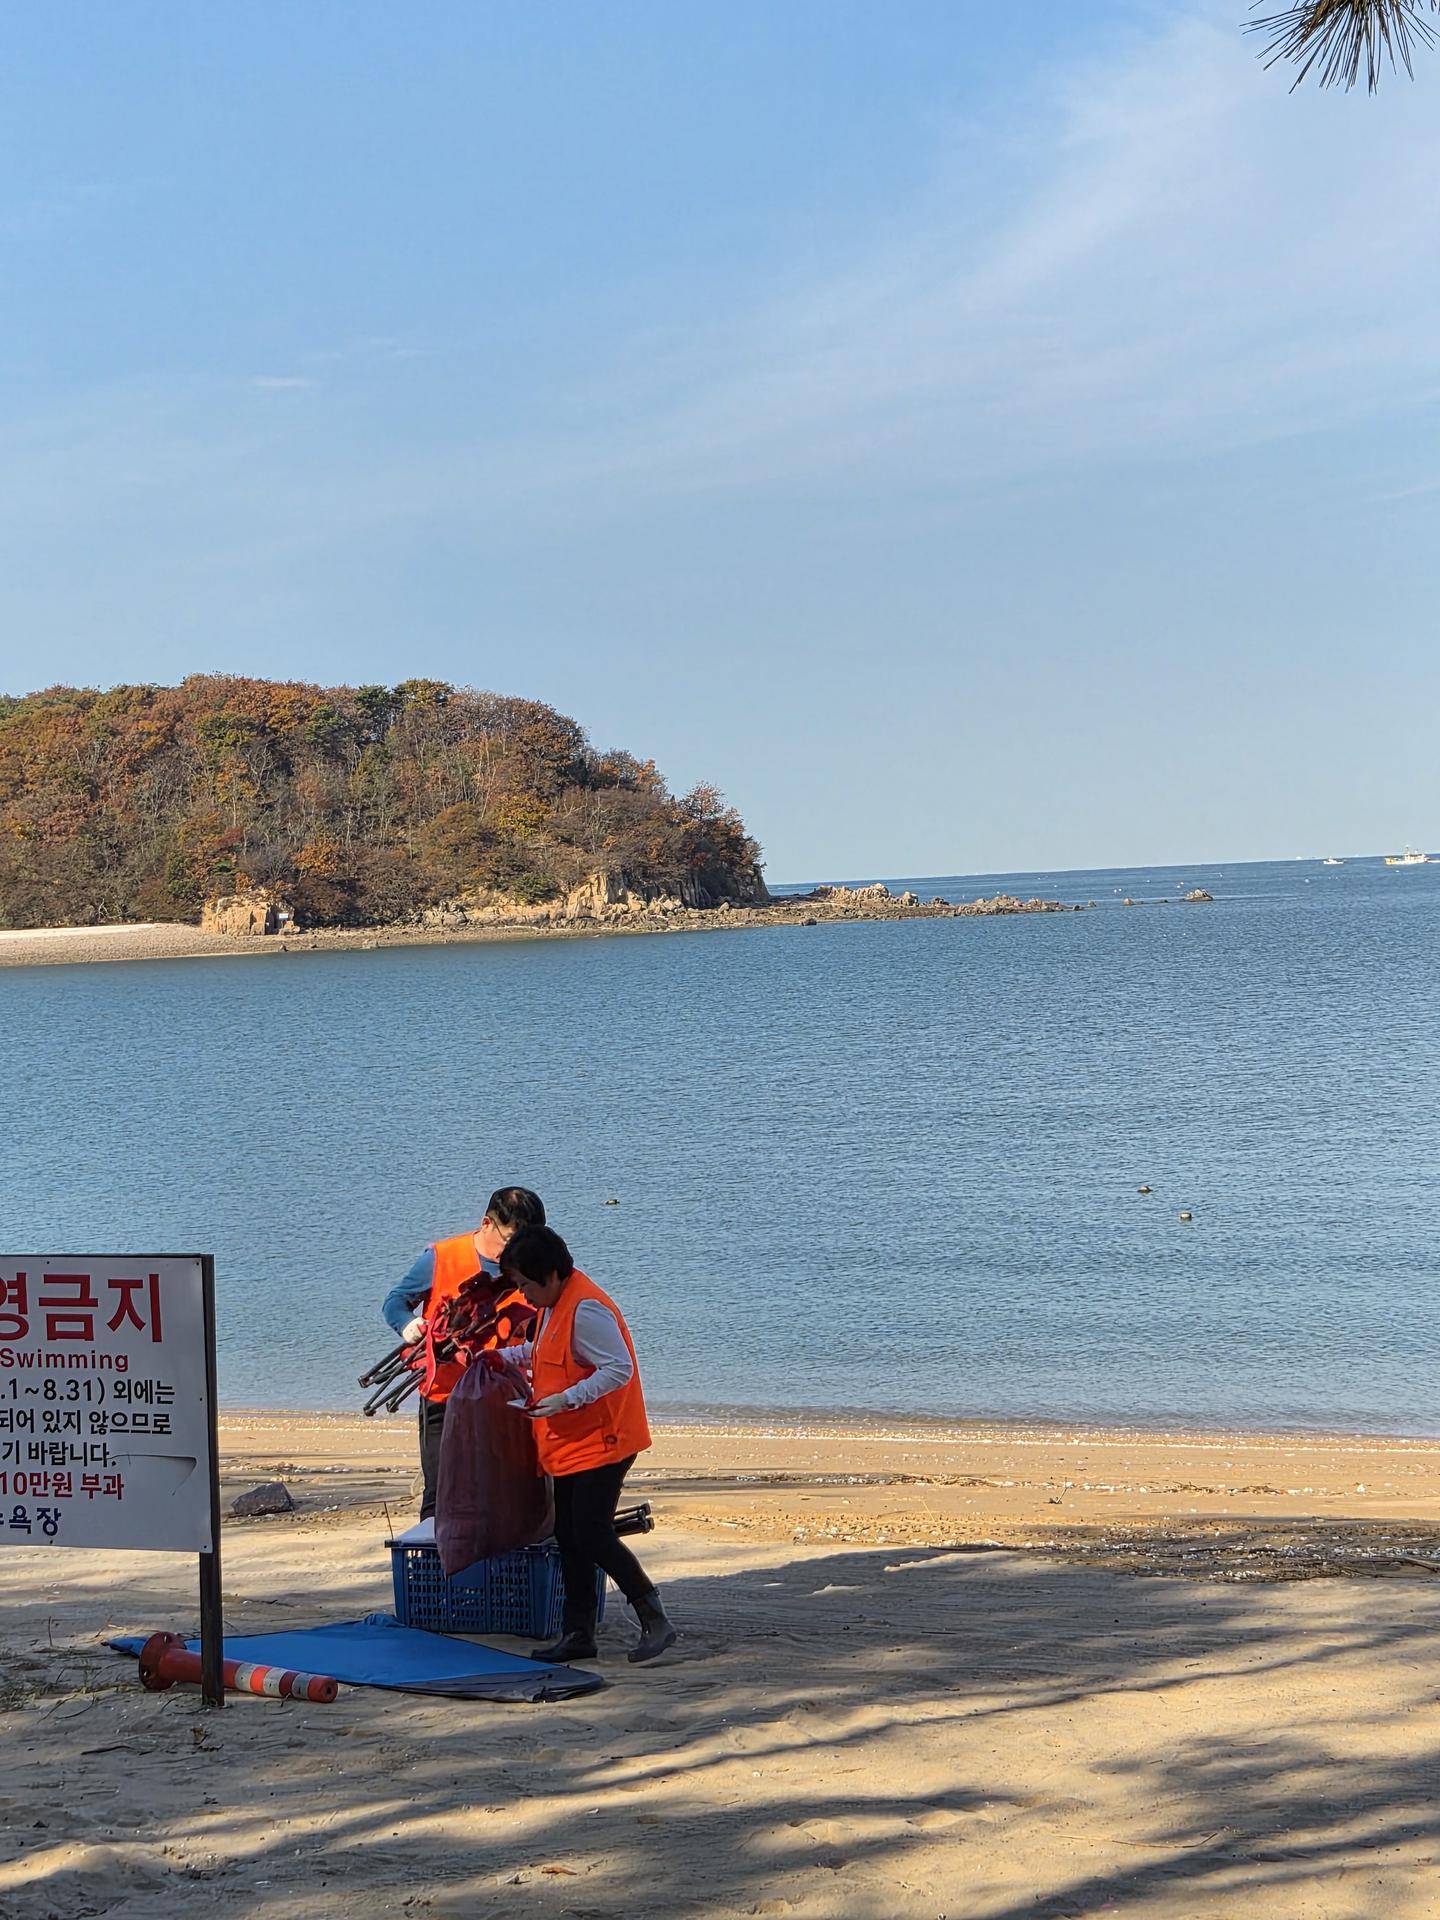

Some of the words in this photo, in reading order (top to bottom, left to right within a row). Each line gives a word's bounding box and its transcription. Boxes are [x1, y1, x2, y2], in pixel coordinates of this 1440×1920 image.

[0, 1347, 129, 1372] Swimming
[113, 1379, 175, 1404] 외에는
[42, 1409, 81, 1435] 있지
[88, 1410, 172, 1436] 않으므로
[2, 1440, 20, 1465] 기
[28, 1441, 117, 1468] 바랍니다.
[0, 1471, 73, 1498] 10만원
[80, 1473, 124, 1501] 부과
[0, 1505, 62, 1536] 욕장
